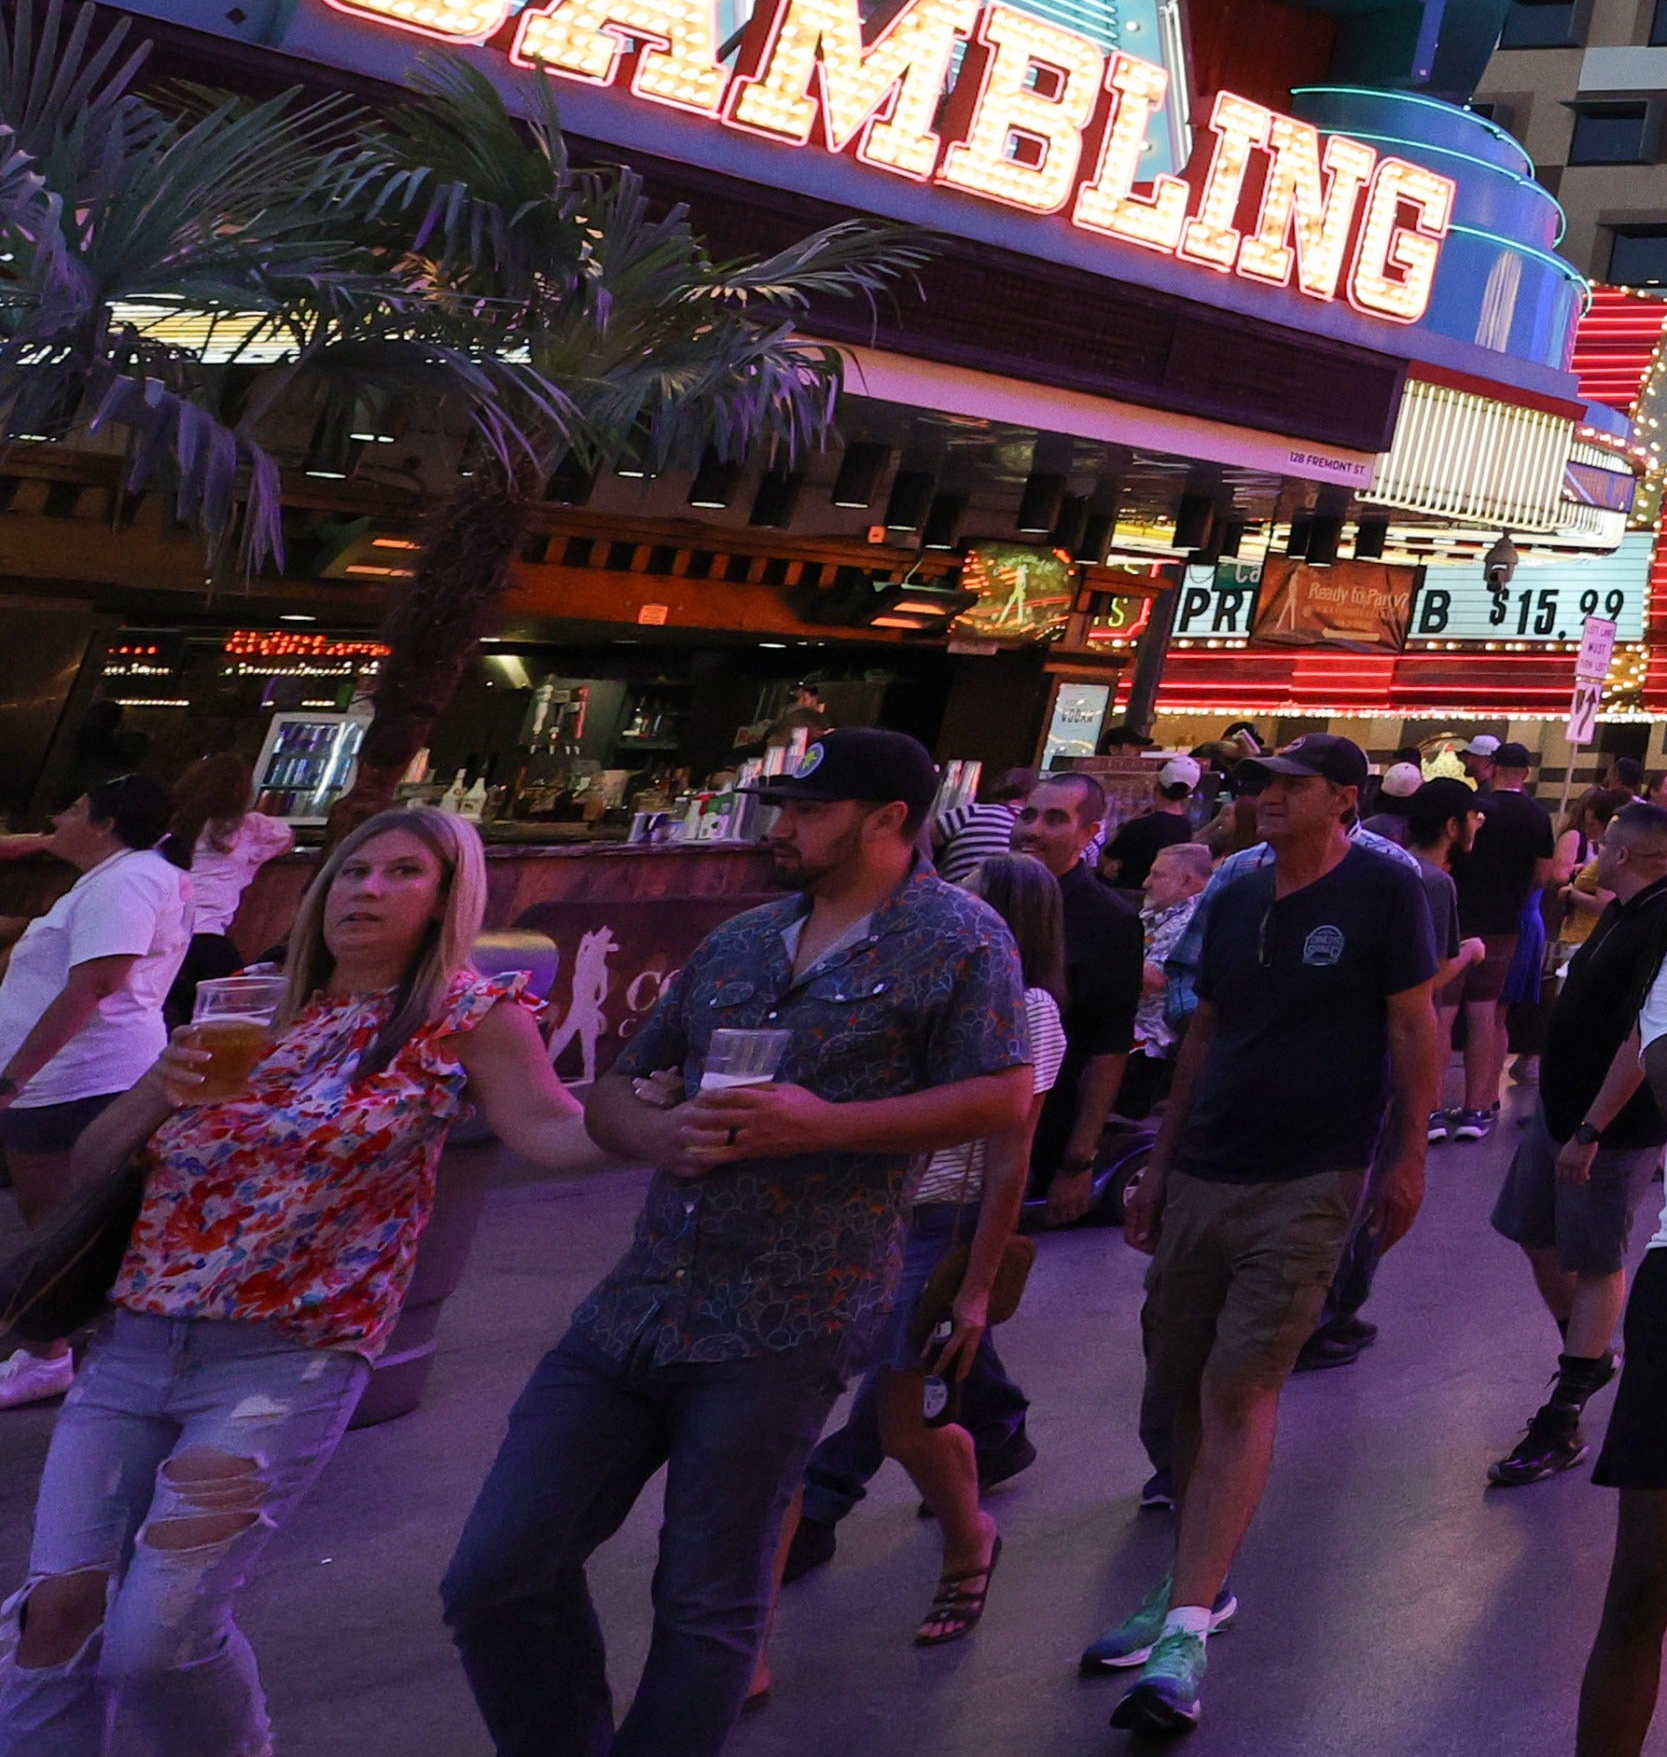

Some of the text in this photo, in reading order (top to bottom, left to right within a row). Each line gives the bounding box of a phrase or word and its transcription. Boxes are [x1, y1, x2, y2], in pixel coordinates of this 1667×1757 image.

[1289, 450, 1304, 464] 128
[1306, 454, 1352, 472] FREMONT
[1309, 582, 1349, 606] Ready
[1488, 587, 1625, 640] $15.99
[1587, 642, 1606, 654] MUST
